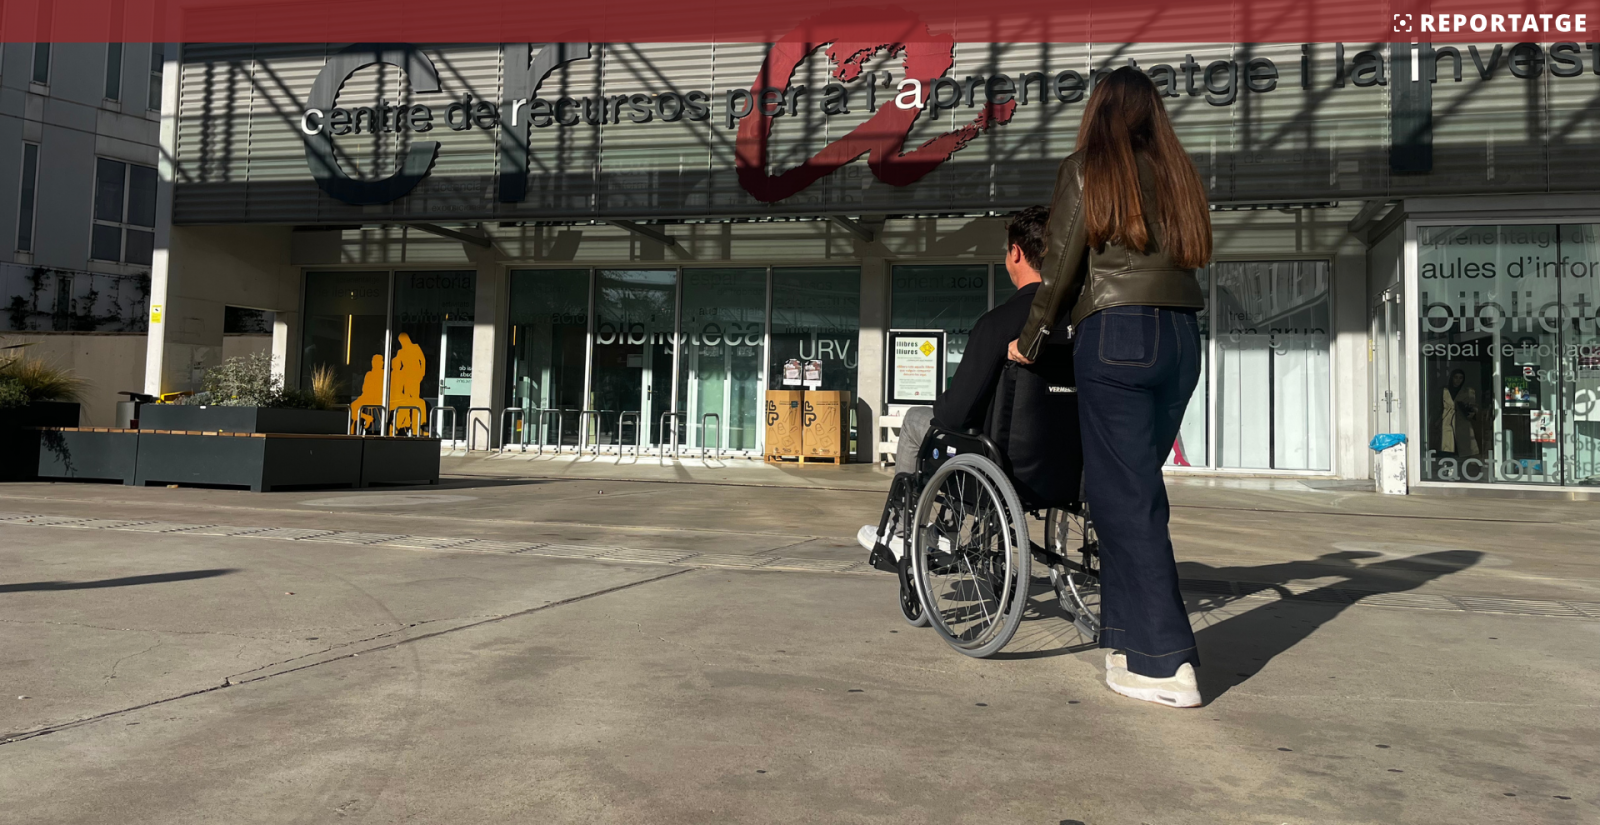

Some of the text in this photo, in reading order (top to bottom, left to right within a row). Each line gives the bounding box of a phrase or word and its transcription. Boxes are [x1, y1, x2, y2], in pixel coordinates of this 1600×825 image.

[300, 98, 434, 136] centre
[445, 92, 498, 131] de
[511, 90, 711, 128] recursos
[726, 85, 806, 130] per
[820, 82, 850, 114] a
[1301, 43, 1312, 90] i
[1336, 39, 1388, 87] la
[1421, 257, 1497, 279] aules
[410, 273, 471, 289] factoria
[690, 271, 736, 289] espai
[1421, 290, 1600, 333] bibliot
[596, 313, 765, 346] biblioteca
[798, 339, 851, 361] URV
[1421, 339, 1480, 361] espai
[1422, 449, 1575, 482] factoria
